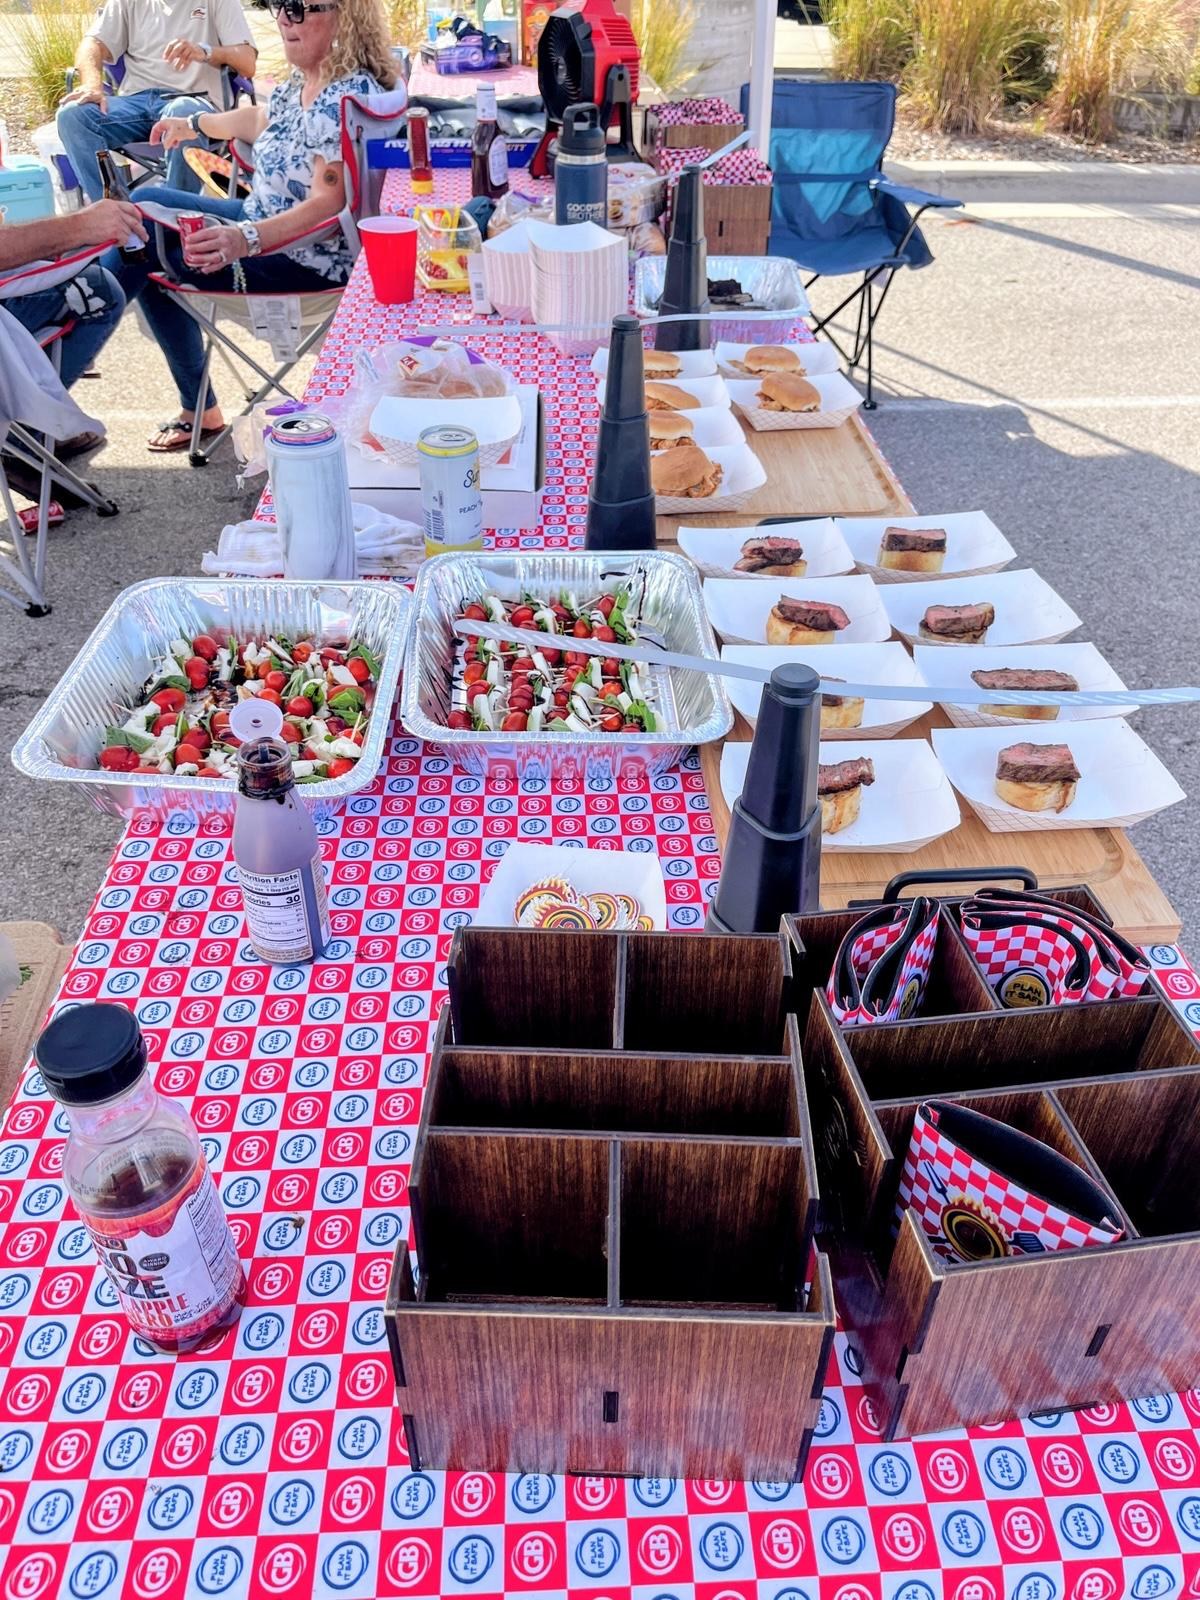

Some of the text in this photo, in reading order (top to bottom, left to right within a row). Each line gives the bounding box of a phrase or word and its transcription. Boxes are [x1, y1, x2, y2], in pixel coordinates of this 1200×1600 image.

[460, 800, 472, 811] GB
[563, 820, 575, 831] GB
[668, 839, 681, 851] GB
[193, 867, 208, 879] GB
[274, 873, 298, 883] Facts
[418, 866, 431, 878] GB
[146, 892, 161, 905] GB
[286, 894, 301, 904] 30
[675, 885, 688, 897] GB
[411, 915, 425, 928] GB
[368, 942, 382, 956] GB
[72, 975, 89, 991] GB
[1012, 982, 1042, 996] PLAN
[273, 1001, 289, 1018] GB
[310, 1032, 326, 1049] GB
[203, 1104, 221, 1123] GB
[296, 1101, 313, 1120] GB
[388, 1096, 404, 1116] GB
[15, 1110, 35, 1130] GB
[241, 1140, 259, 1161] GB
[337, 1136, 354, 1157] GB
[281, 1179, 299, 1201] GB
[379, 1175, 396, 1196] GB
[323, 1220, 342, 1243] GB
[15, 1233, 36, 1256] GB
[263, 1269, 282, 1293] GB
[368, 1264, 386, 1288] GB
[51, 1278, 72, 1303] GB
[308, 1315, 327, 1342] GB
[89, 1326, 110, 1353] GB
[83, 1380, 93, 1397] SAFE
[188, 1379, 197, 1398] PLAN
[195, 1376, 205, 1393] SAFE
[242, 1372, 263, 1400] GB
[301, 1373, 309, 1392] PLAN
[308, 1369, 317, 1387] SAFE
[355, 1366, 375, 1394] GB
[17, 1381, 39, 1409] GB
[75, 1383, 85, 1402] PLAN
[129, 1378, 151, 1405] GB
[124, 1434, 134, 1453] SAFE
[233, 1433, 242, 1453] PLAN
[241, 1429, 250, 1448] SAFE
[290, 1426, 311, 1456] GB
[358, 1424, 366, 1442] SAFE
[56, 1436, 79, 1465] GB
[116, 1438, 126, 1458] PLAN
[172, 1431, 194, 1461] GB
[996, 1458, 1006, 1477] PLAN
[1001, 1454, 1012, 1472] SAFE
[1050, 1450, 1074, 1480] GB
[1109, 1452, 1120, 1472] PLAN
[1114, 1448, 1126, 1467] SAFE
[1162, 1444, 1186, 1474] GB
[820, 1461, 842, 1492] GB
[881, 1463, 890, 1483] PLAN
[887, 1459, 898, 1488] IT SAFE
[936, 1456, 959, 1486] GB
[49, 1497, 60, 1516] SAFE
[219, 1489, 241, 1521] GB
[283, 1491, 291, 1513] PLAN
[290, 1487, 299, 1507] SAFE
[341, 1484, 362, 1516] GB
[411, 1481, 420, 1511] IT SAFE
[41, 1501, 51, 1522] PLAN
[97, 1494, 121, 1526] GB
[161, 1497, 171, 1517] PLAN
[167, 1492, 179, 1522] IT SAFE
[960, 1518, 970, 1539] SAFE
[1011, 1514, 1034, 1546] GB
[1072, 1516, 1083, 1537] PLAN
[1078, 1511, 1089, 1531] SAFE
[1128, 1507, 1152, 1539] GB
[720, 1531, 728, 1552] SAFE
[771, 1527, 793, 1560] GB
[834, 1529, 843, 1551] PLAN
[840, 1524, 850, 1545] SAFE
[892, 1520, 915, 1553] GB
[954, 1522, 964, 1544] PLAN
[523, 1540, 543, 1573] GB
[649, 1534, 670, 1566] GB
[713, 1535, 721, 1557] PLAN
[218, 1554, 228, 1575] SAFE
[271, 1551, 293, 1585] GB
[336, 1554, 344, 1576] PLAN
[343, 1549, 353, 1581] IT SAFE
[397, 1545, 419, 1579] GB
[469, 1543, 478, 1574] IT SAFE
[597, 1560, 604, 1568] IT
[18, 1561, 43, 1595] GB
[84, 1563, 94, 1585] PLAN
[90, 1559, 103, 1590] IT SAFE
[144, 1556, 168, 1589] GB
[209, 1558, 219, 1581] PLAN
